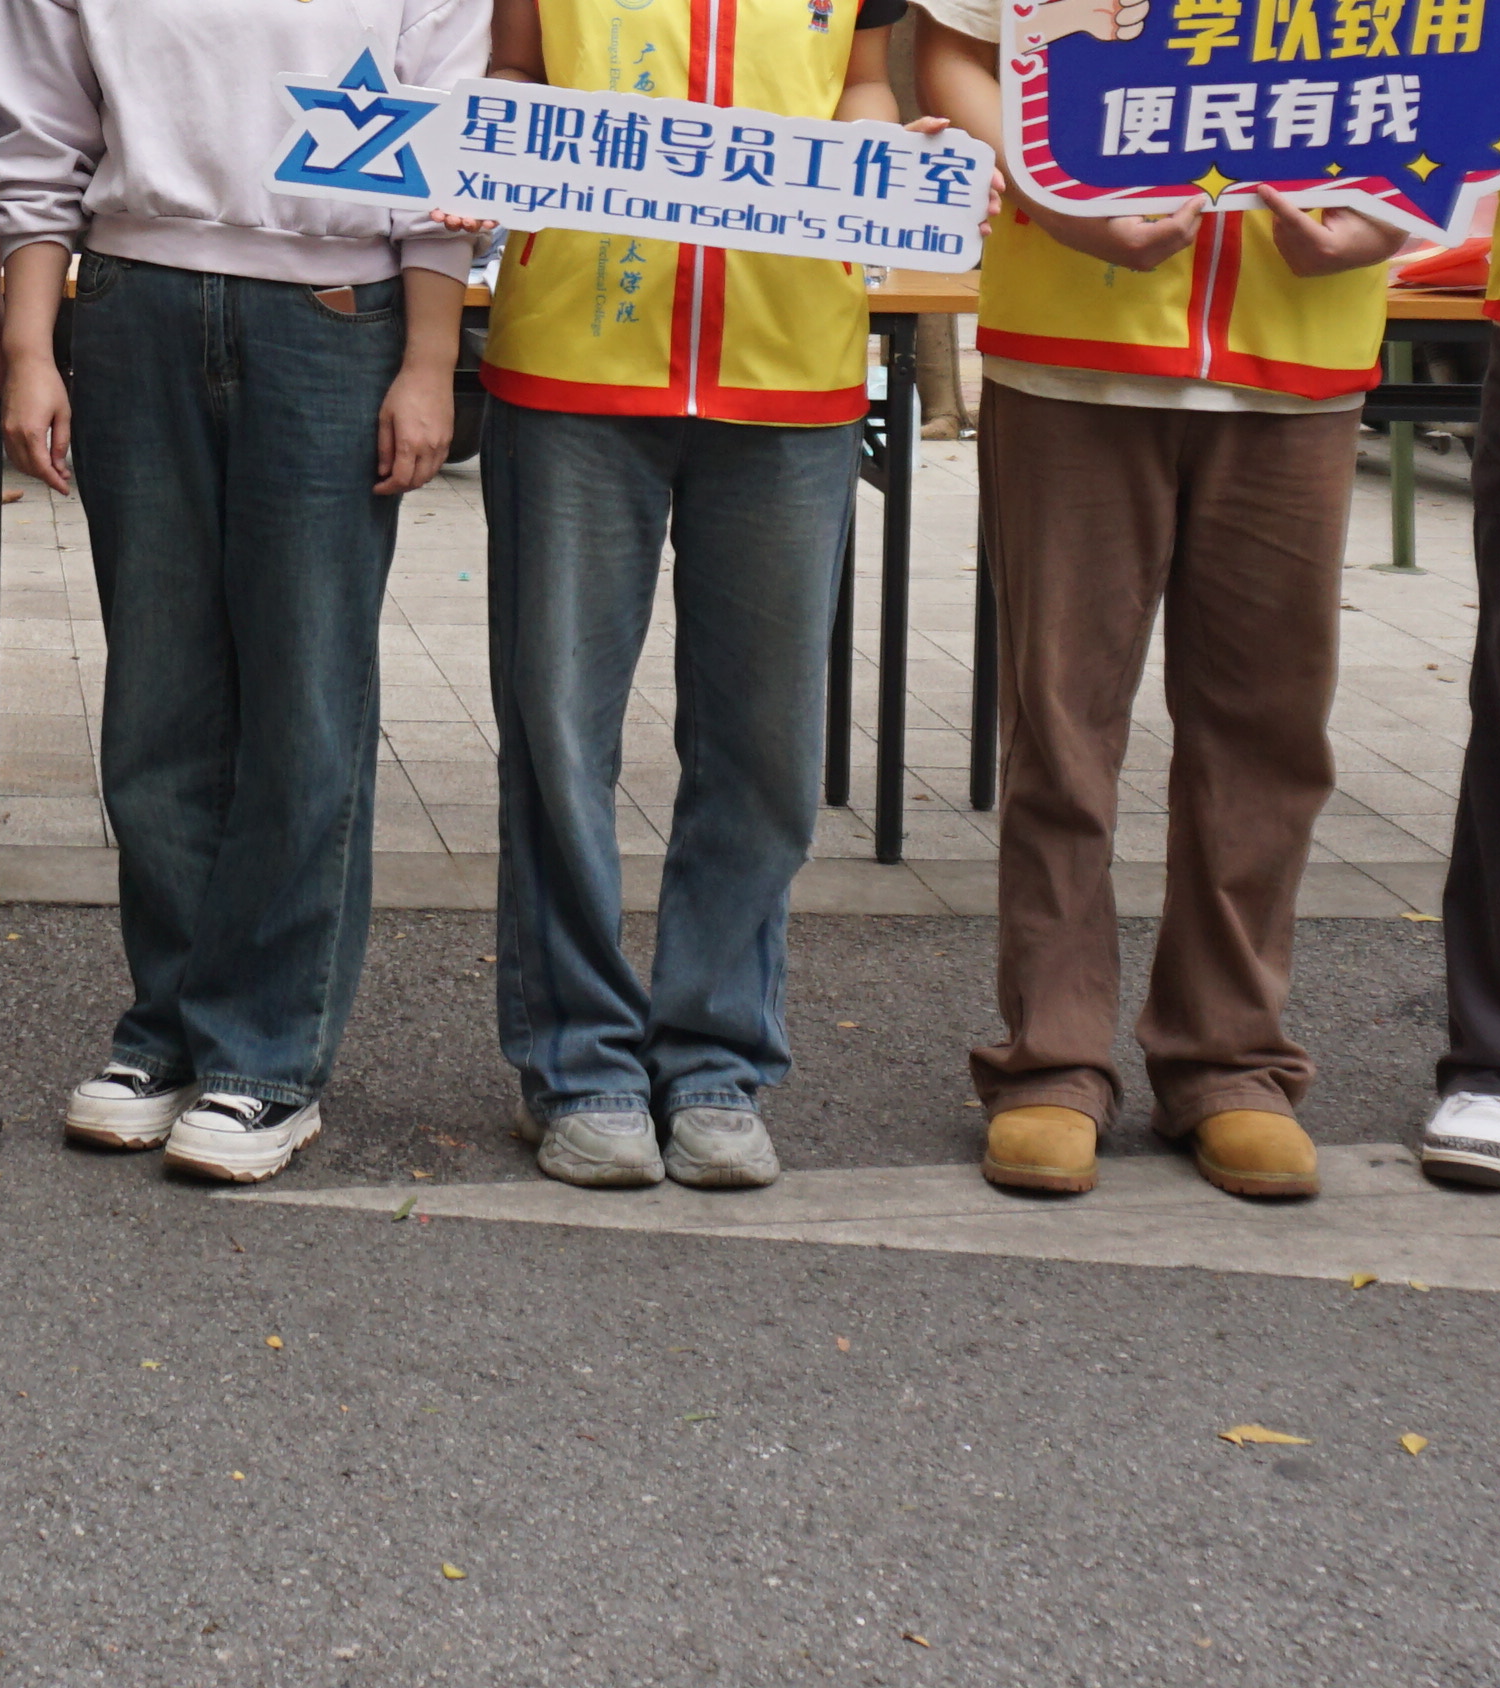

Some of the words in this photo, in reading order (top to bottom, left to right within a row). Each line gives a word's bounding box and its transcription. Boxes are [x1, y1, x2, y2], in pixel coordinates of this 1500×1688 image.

[460, 94, 979, 209] 星职辅导员工作室
[1101, 74, 1422, 159] 便民有我
[453, 170, 595, 212] Xingzhi
[601, 186, 827, 241] Counselor's
[835, 215, 965, 257] Studio
